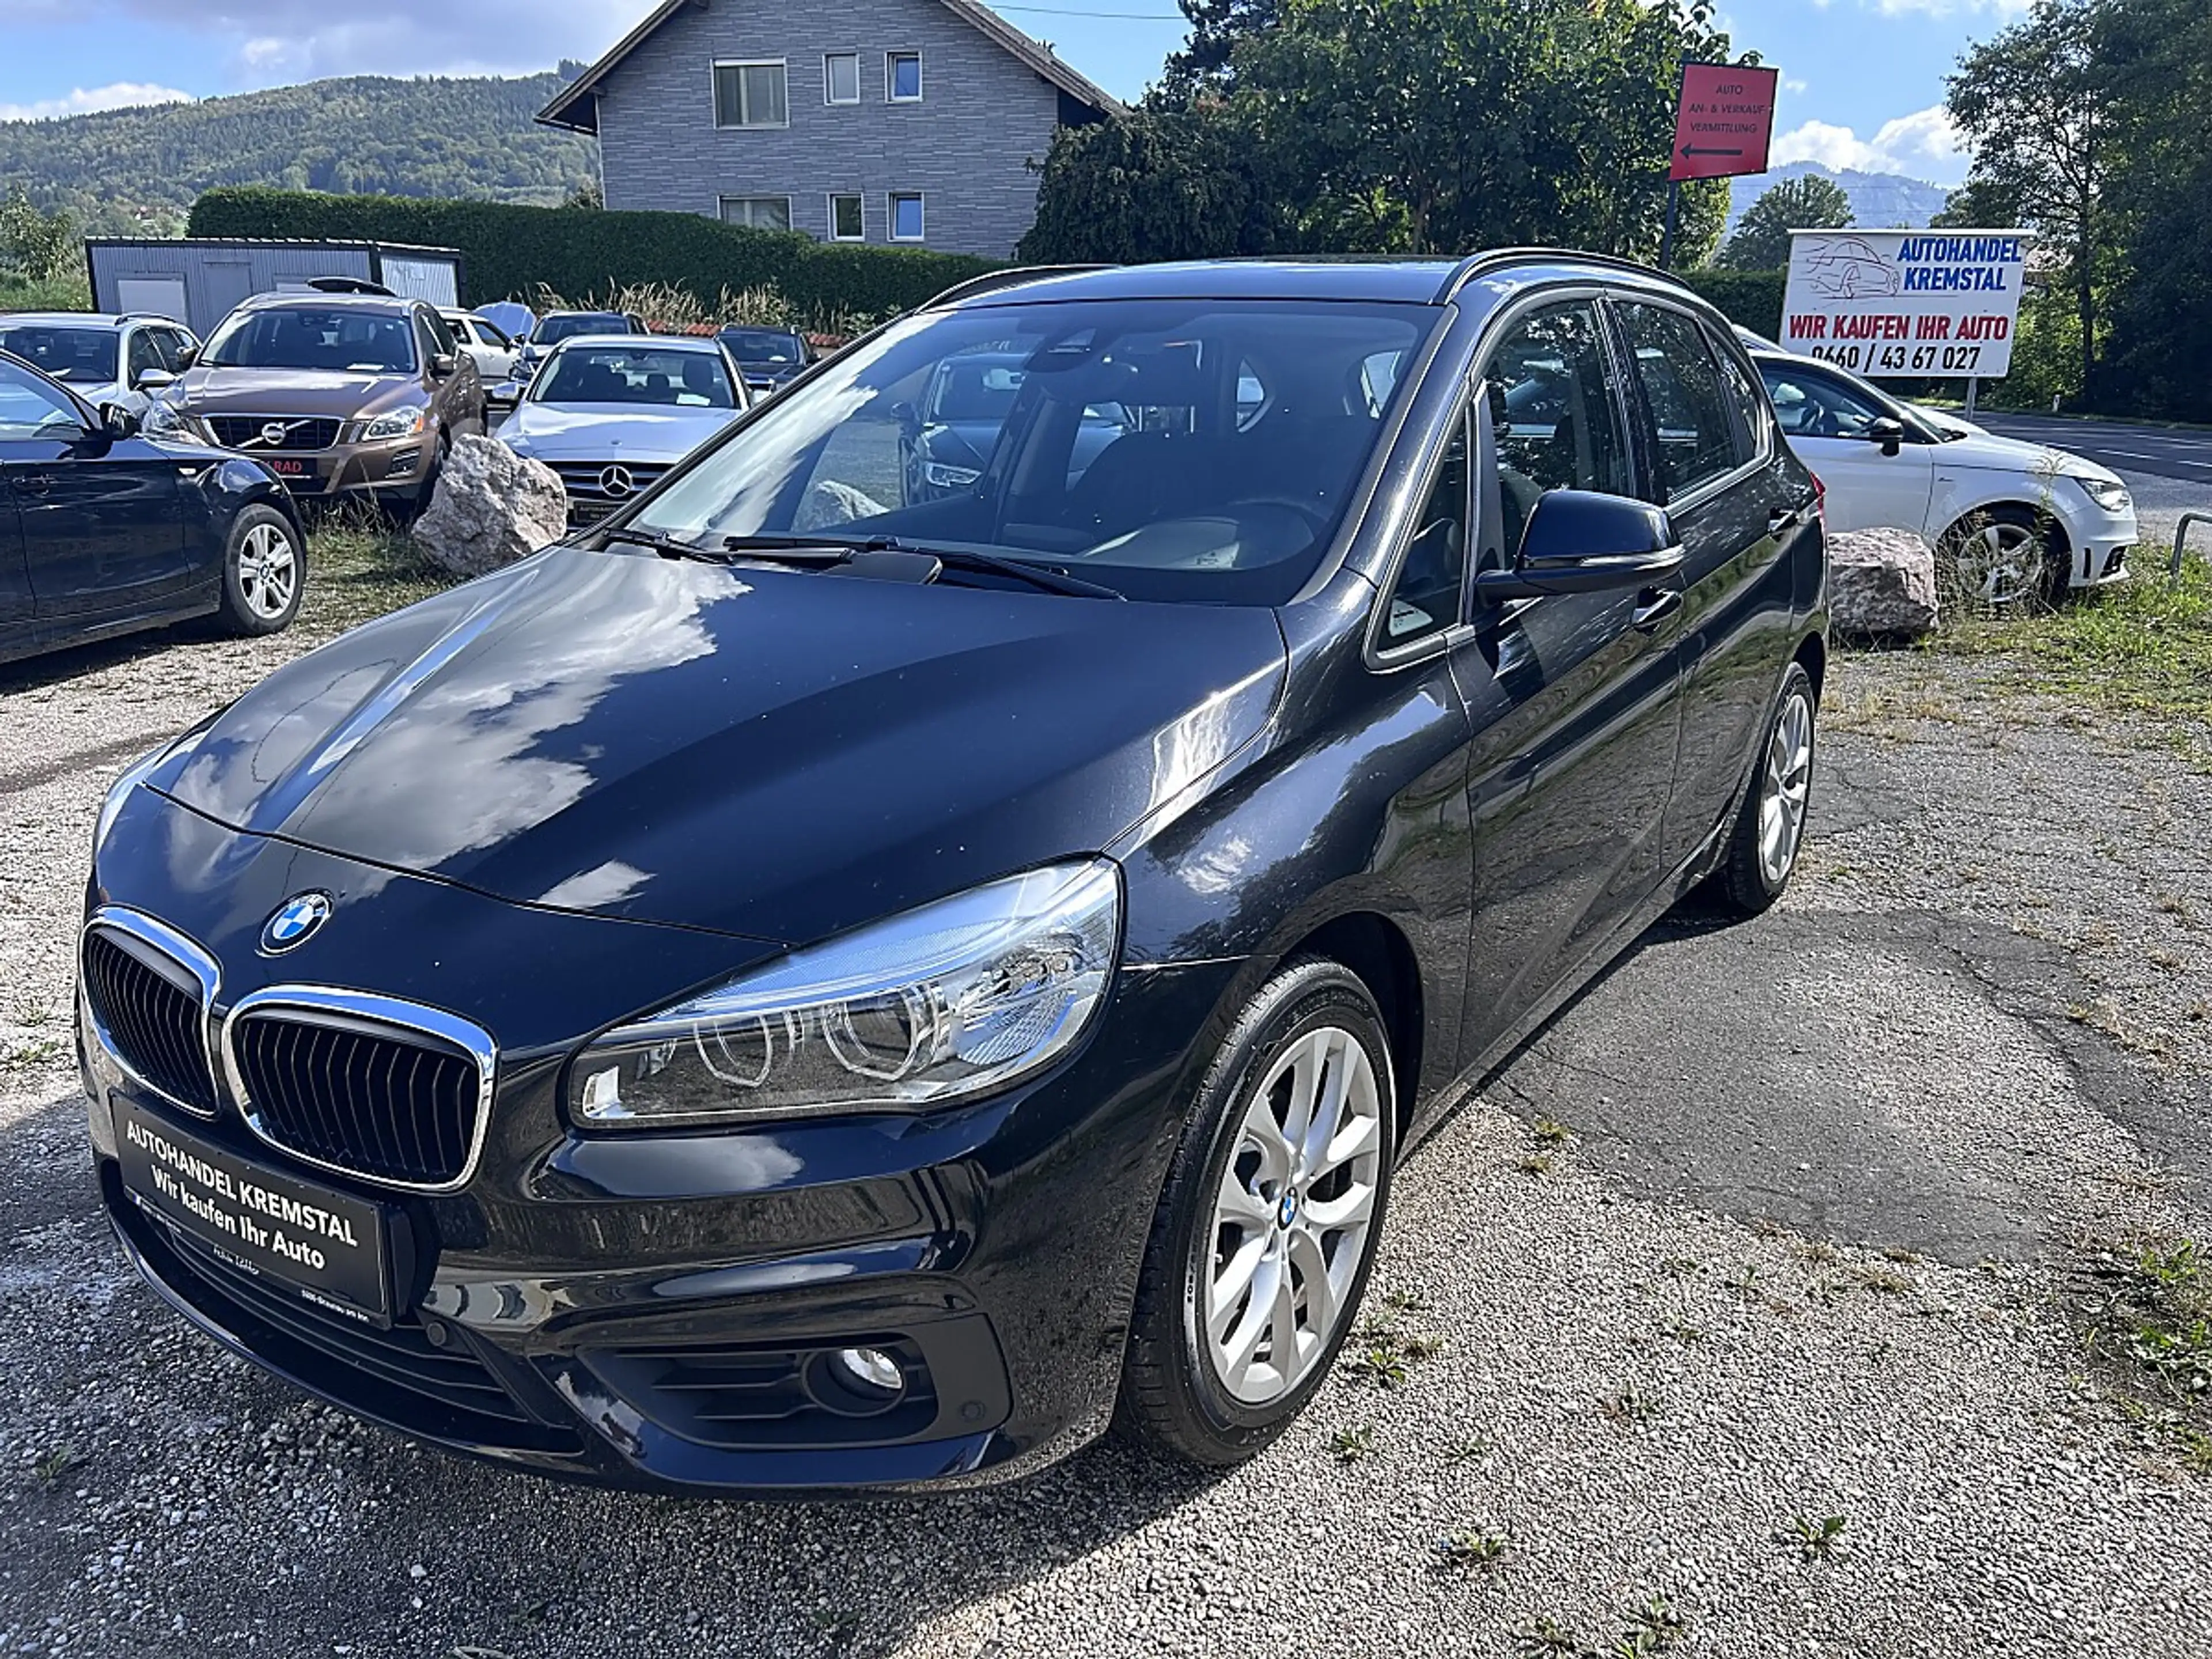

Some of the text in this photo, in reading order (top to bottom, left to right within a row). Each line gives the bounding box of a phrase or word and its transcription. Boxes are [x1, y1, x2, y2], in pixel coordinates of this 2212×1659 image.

[1716, 85, 1743, 95] AUTO
[1710, 104, 1718, 113] &
[1690, 122, 1758, 133] VERMITTLUNG
[1897, 237, 2022, 263] AUTOHANDEL
[1903, 267, 2007, 290] KREMSTAL
[1789, 315, 2009, 340] WIR KAUFEN IHR AUTO
[1880, 346, 1906, 370] 43
[1911, 346, 1937, 370] 67
[1942, 346, 1981, 370] 027
[127, 1119, 237, 1201] AUTOHANDEL
[239, 1180, 359, 1248] KREMSTAL
[150, 1164, 178, 1199] Wir
[180, 1181, 237, 1234] kaufen
[239, 1214, 268, 1248] Ihr
[271, 1229, 325, 1270] Auto
